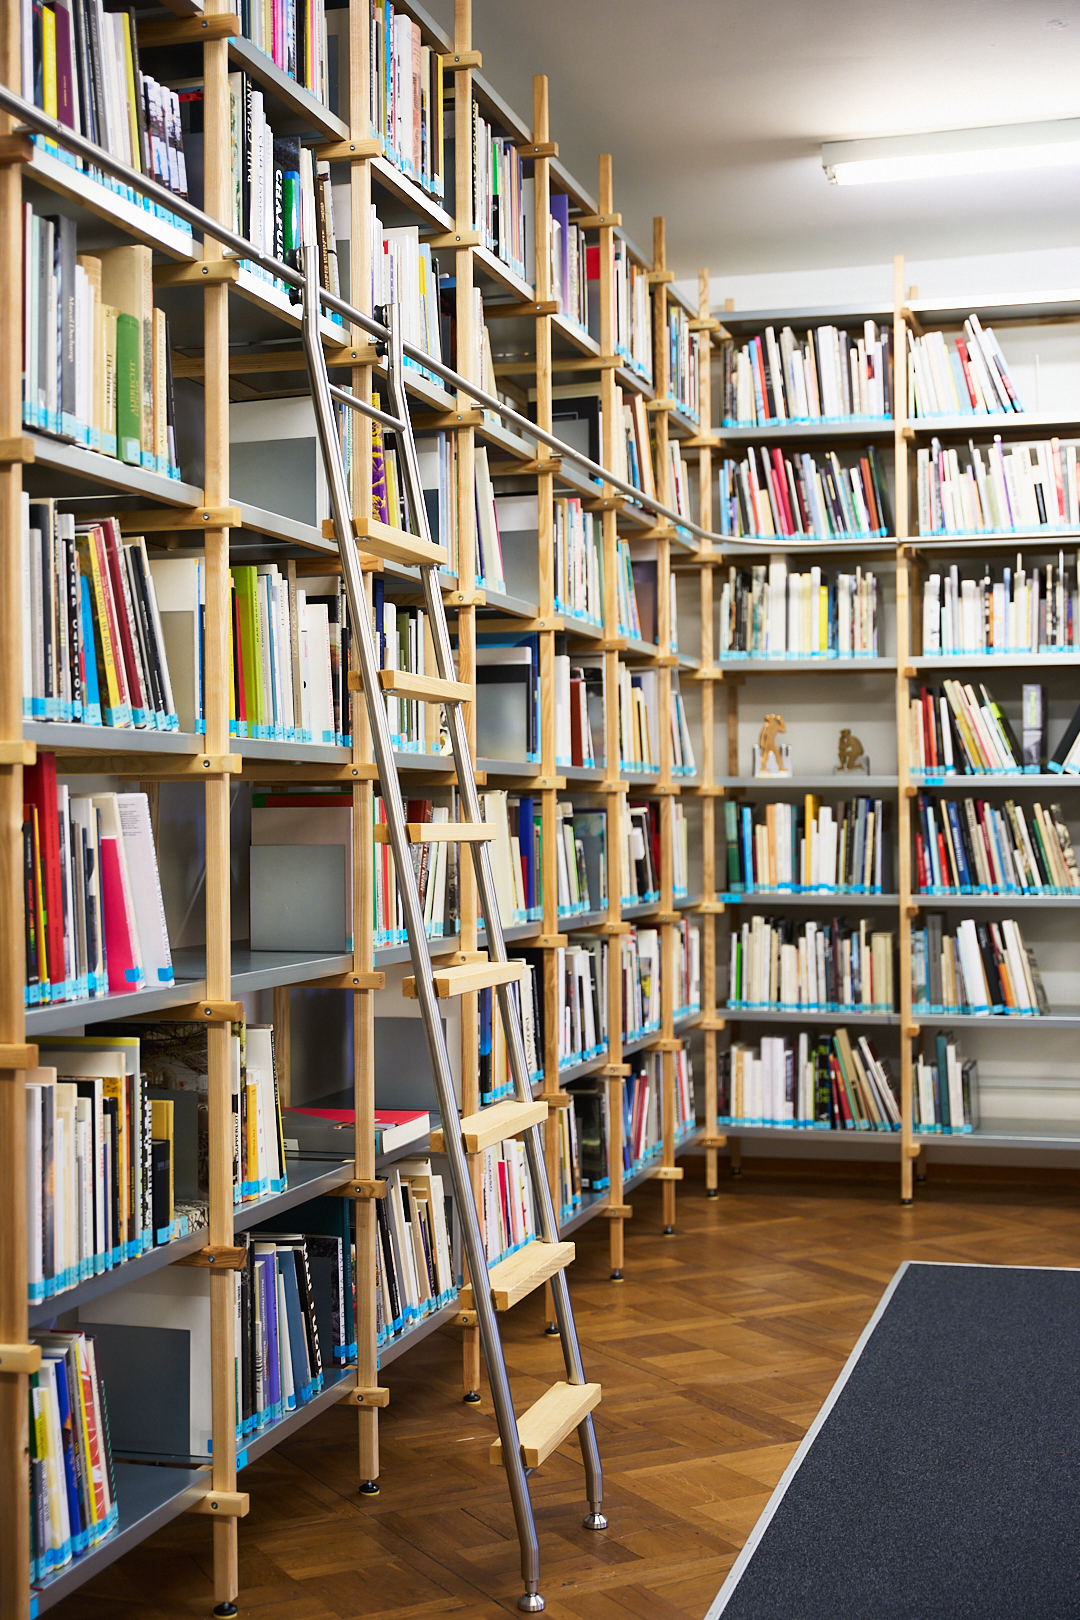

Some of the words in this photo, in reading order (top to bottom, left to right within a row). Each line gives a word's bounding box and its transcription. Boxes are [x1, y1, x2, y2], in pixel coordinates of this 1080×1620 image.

[91, 13, 99, 43] Luis
[94, 47, 104, 118] Camnitzer
[104, 636, 113, 666] ARLES
